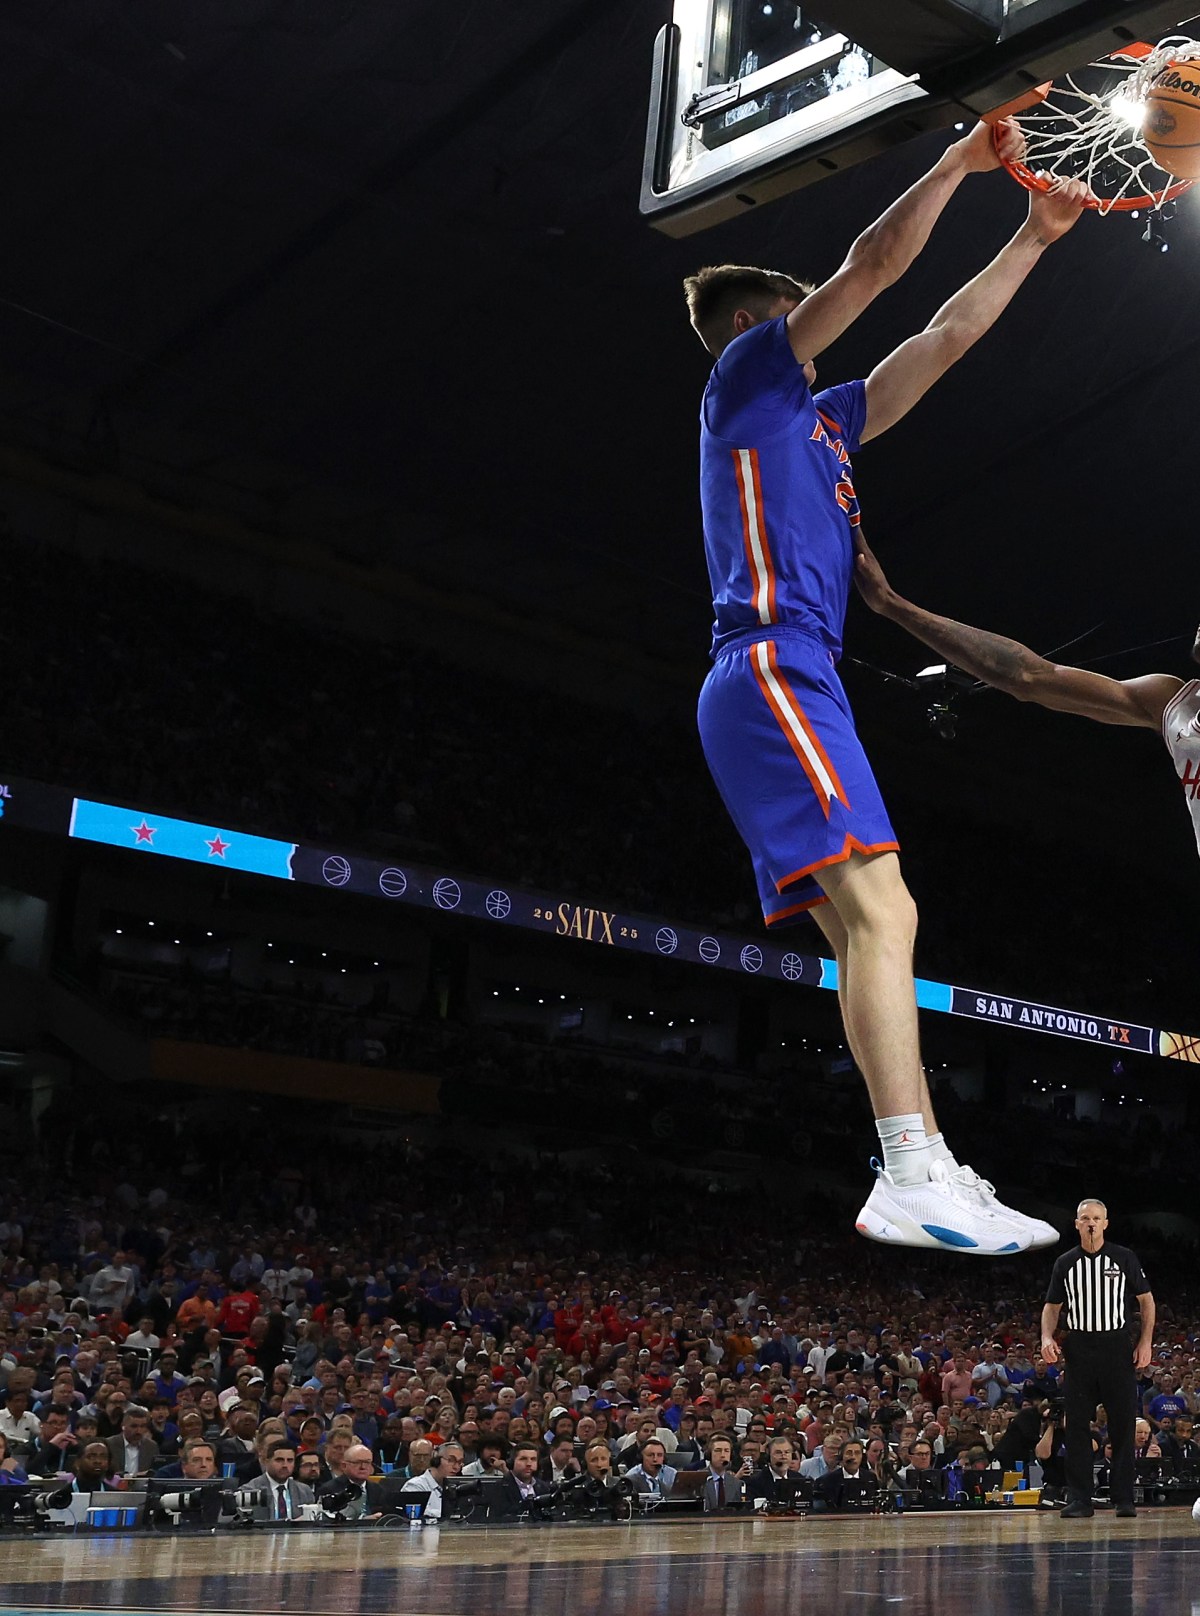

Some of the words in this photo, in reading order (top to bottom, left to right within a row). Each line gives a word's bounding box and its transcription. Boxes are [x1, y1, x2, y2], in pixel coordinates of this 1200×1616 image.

[533, 908, 553, 920] 20
[556, 902, 616, 945] SATX
[620, 927, 638, 939] 25
[976, 997, 1013, 1020] SAN
[1019, 1007, 1102, 1040] ANTONIO,
[1108, 1025, 1130, 1044] TX
